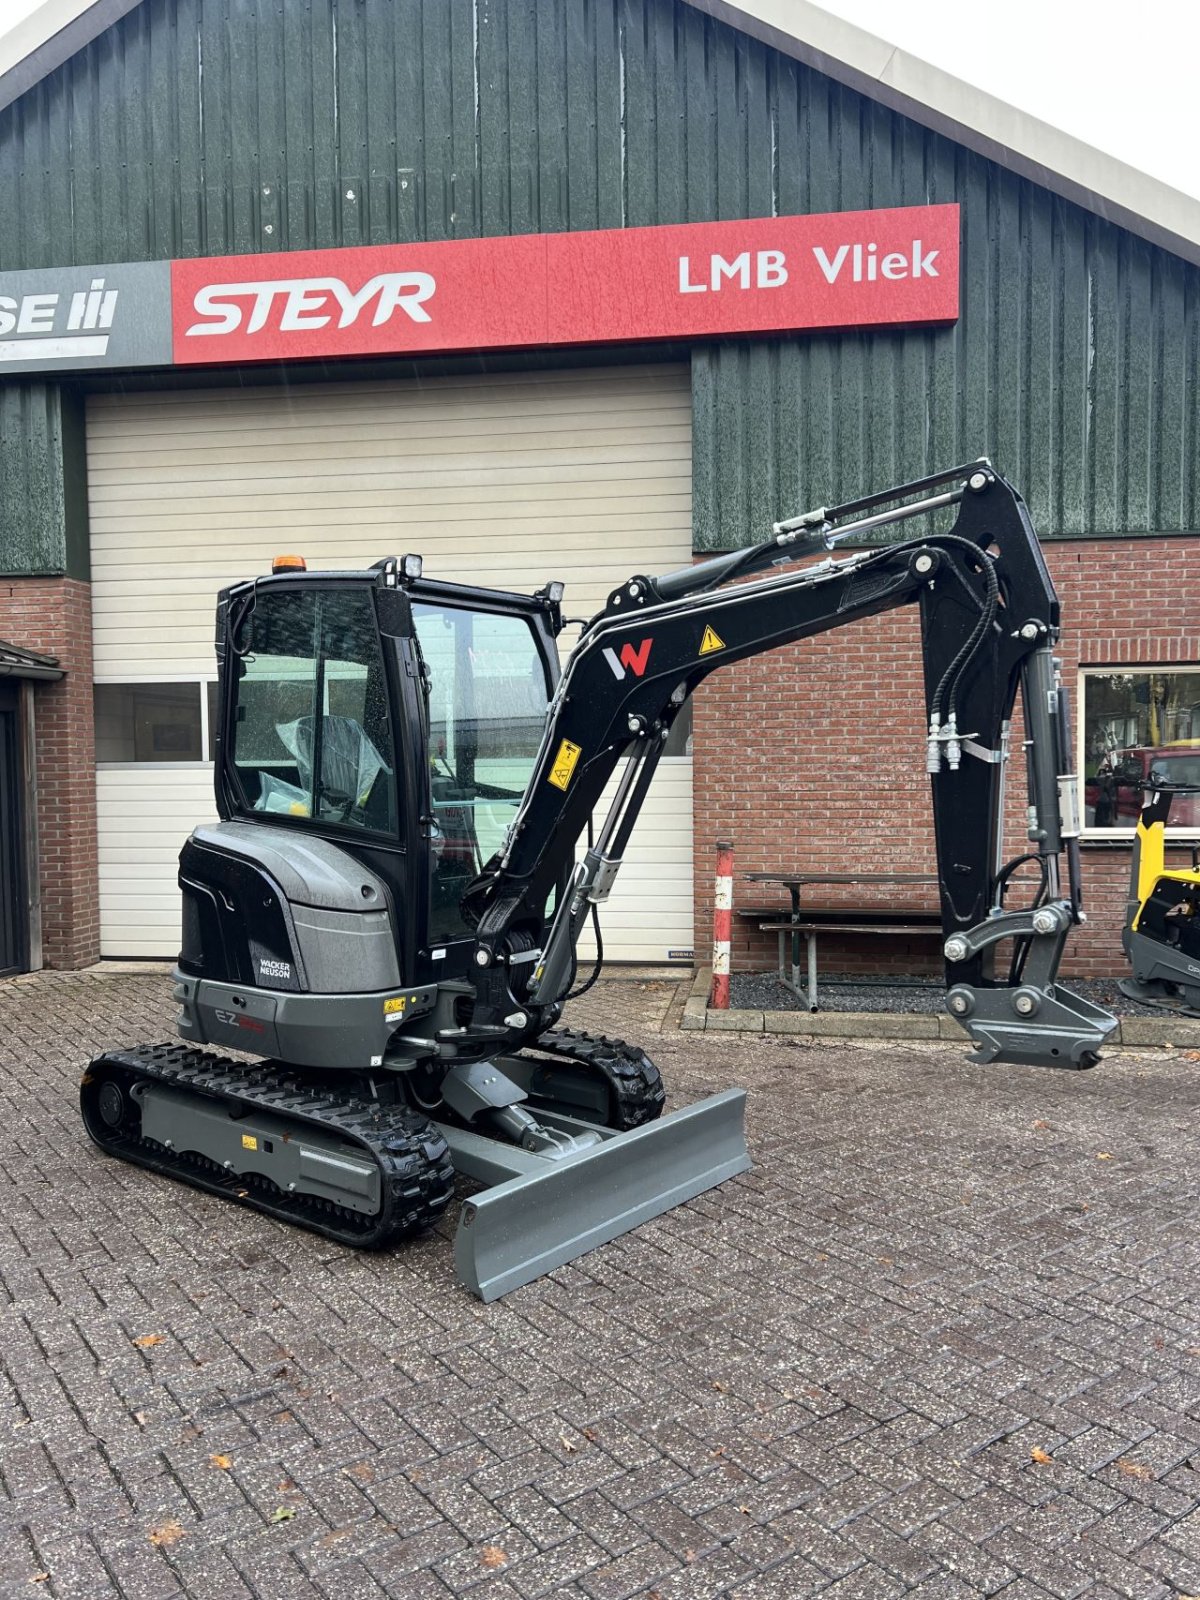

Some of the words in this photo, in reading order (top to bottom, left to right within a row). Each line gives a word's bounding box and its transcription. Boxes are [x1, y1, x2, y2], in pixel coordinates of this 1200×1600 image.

[679, 249, 789, 294] LMB
[812, 239, 941, 285] Vliek
[185, 271, 437, 337] STEYR
[260, 959, 290, 971] WACKER
[260, 966, 290, 979] NEUSON
